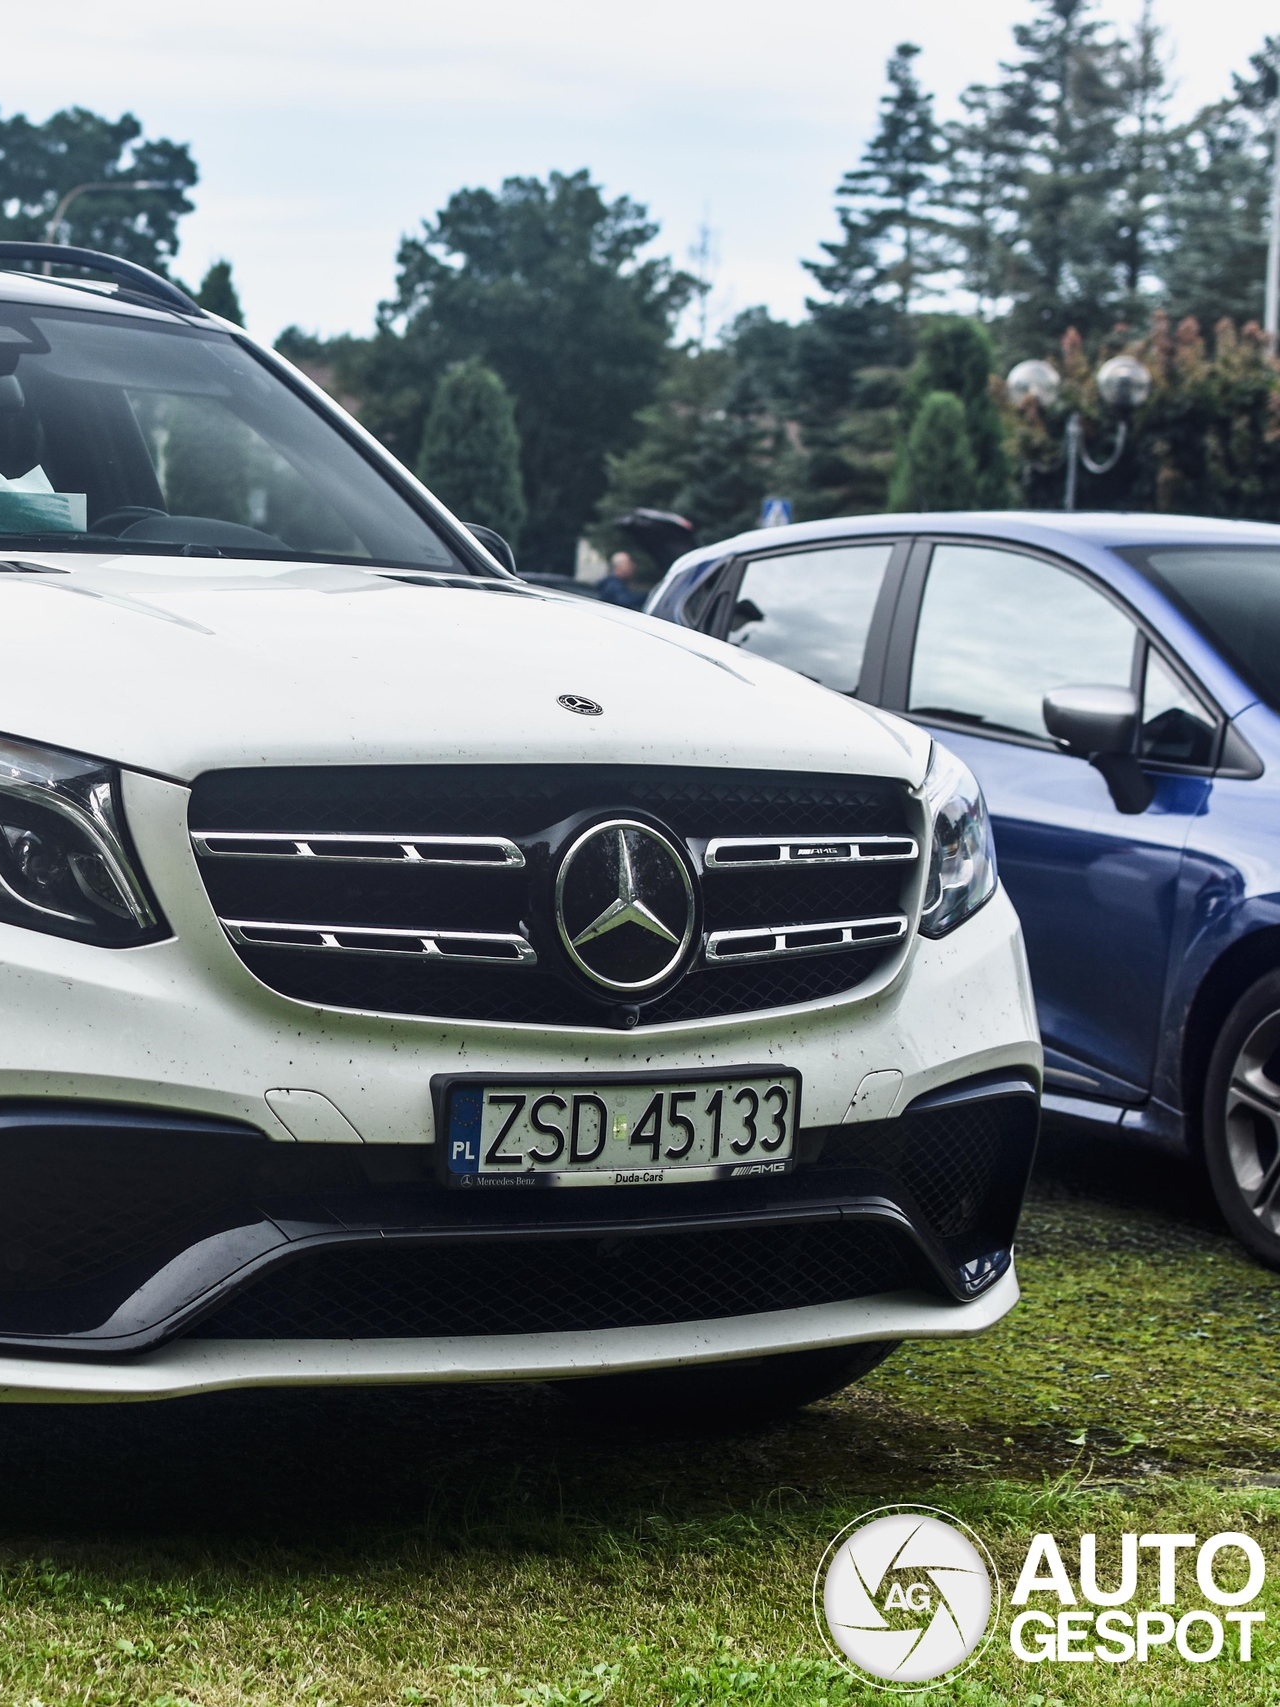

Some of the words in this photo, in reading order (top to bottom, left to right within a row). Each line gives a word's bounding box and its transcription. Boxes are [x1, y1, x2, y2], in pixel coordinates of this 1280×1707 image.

[810, 847, 838, 855] AMG
[483, 1093, 608, 1165] ZSD
[630, 1085, 789, 1161] 45133
[452, 1141, 475, 1160] PL
[749, 1162, 786, 1175] AMG
[477, 1176, 536, 1187] Mercedes-Benz
[615, 1172, 664, 1184] Duda-Cars
